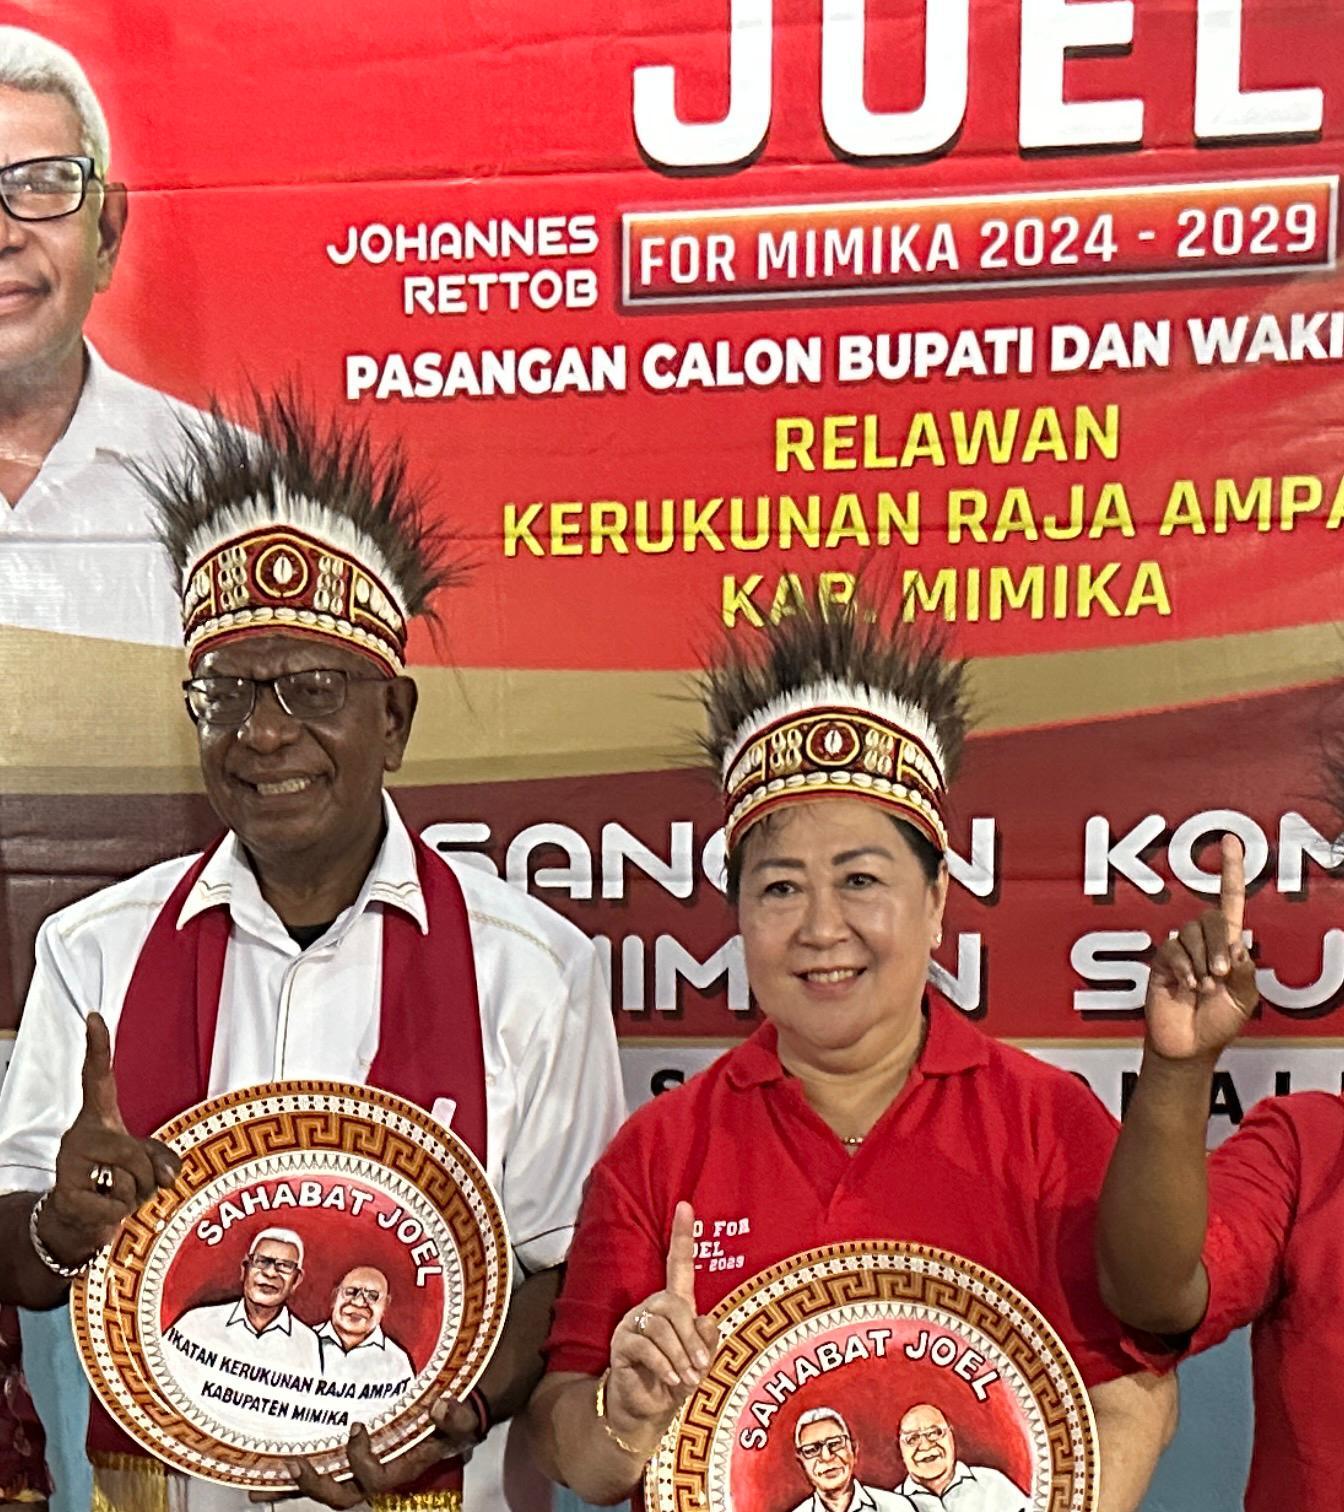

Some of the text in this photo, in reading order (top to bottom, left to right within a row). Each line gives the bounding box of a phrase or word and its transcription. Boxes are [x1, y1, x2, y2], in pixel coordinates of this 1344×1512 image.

[632, 0, 1324, 170] JOEL
[326, 215, 598, 265] JOHANNES
[640, 235, 736, 286] FOR
[758, 222, 959, 280] MIMIKA
[979, 213, 1118, 269] 2024
[1176, 202, 1317, 258] 2029
[404, 268, 598, 315] RETTOB
[346, 345, 627, 400] PASANGAN
[642, 336, 822, 390] CALON
[839, 326, 1034, 381] BUPATI
[1050, 319, 1170, 373] DAN
[775, 404, 1120, 472] RELAWAN
[502, 491, 920, 557] KERUKUNAN
[947, 482, 1136, 543] RAJA
[902, 559, 1174, 624] MIMIKA
[195, 1180, 444, 1288] SAHABAT JOEL
[167, 1327, 412, 1400] IKATAN KERUKUNAN RAJA AMPAT
[201, 1380, 290, 1418] KABUPATEN
[740, 1328, 1002, 1451] SAHABAT JOEL
